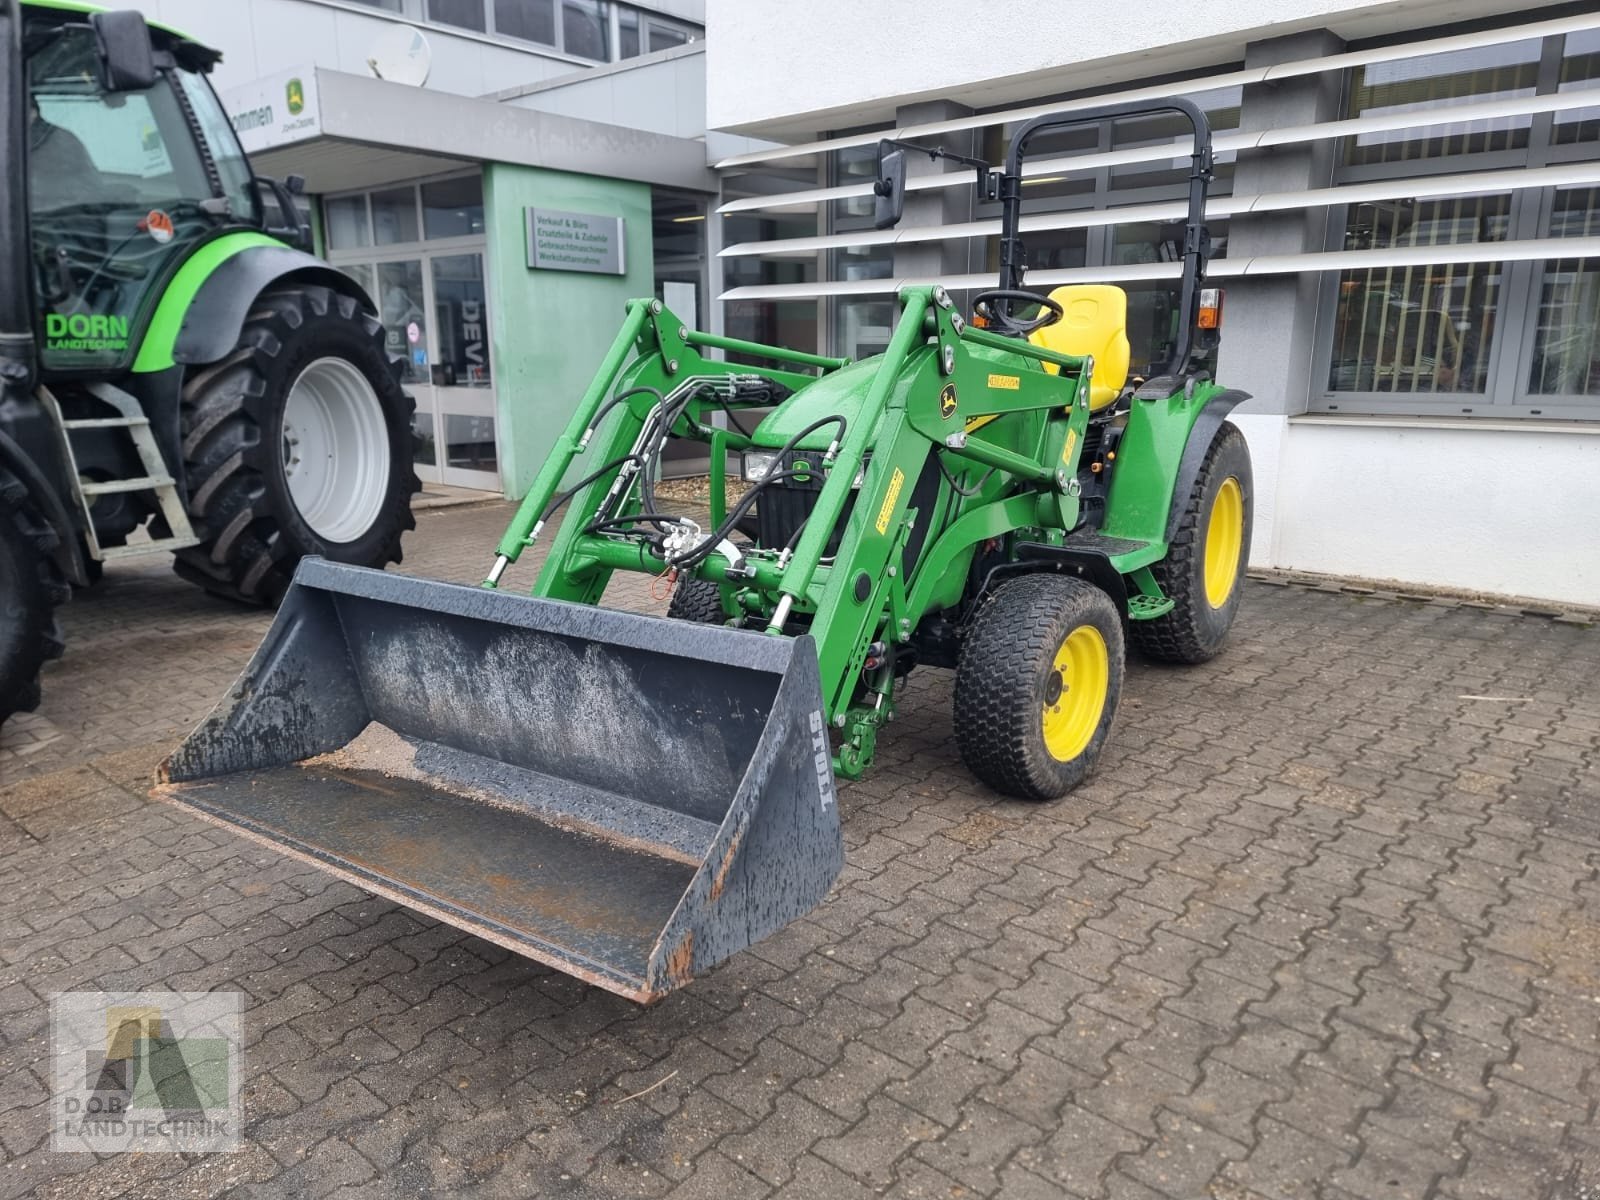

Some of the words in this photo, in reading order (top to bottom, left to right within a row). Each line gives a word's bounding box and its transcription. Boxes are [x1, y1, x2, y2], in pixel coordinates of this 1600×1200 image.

[537, 216, 563, 226] Verkauf
[565, 219, 571, 228] &
[572, 221, 588, 230] Büro
[537, 228, 573, 240] Ersatzteile
[575, 232, 580, 240] &
[538, 240, 608, 254] Gebrauchtmaschinen
[539, 252, 601, 265] Werkstattannahme
[47, 314, 128, 338] DORN
[47, 339, 128, 350] LANDTECHNIK
[809, 710, 833, 812] STOLL
